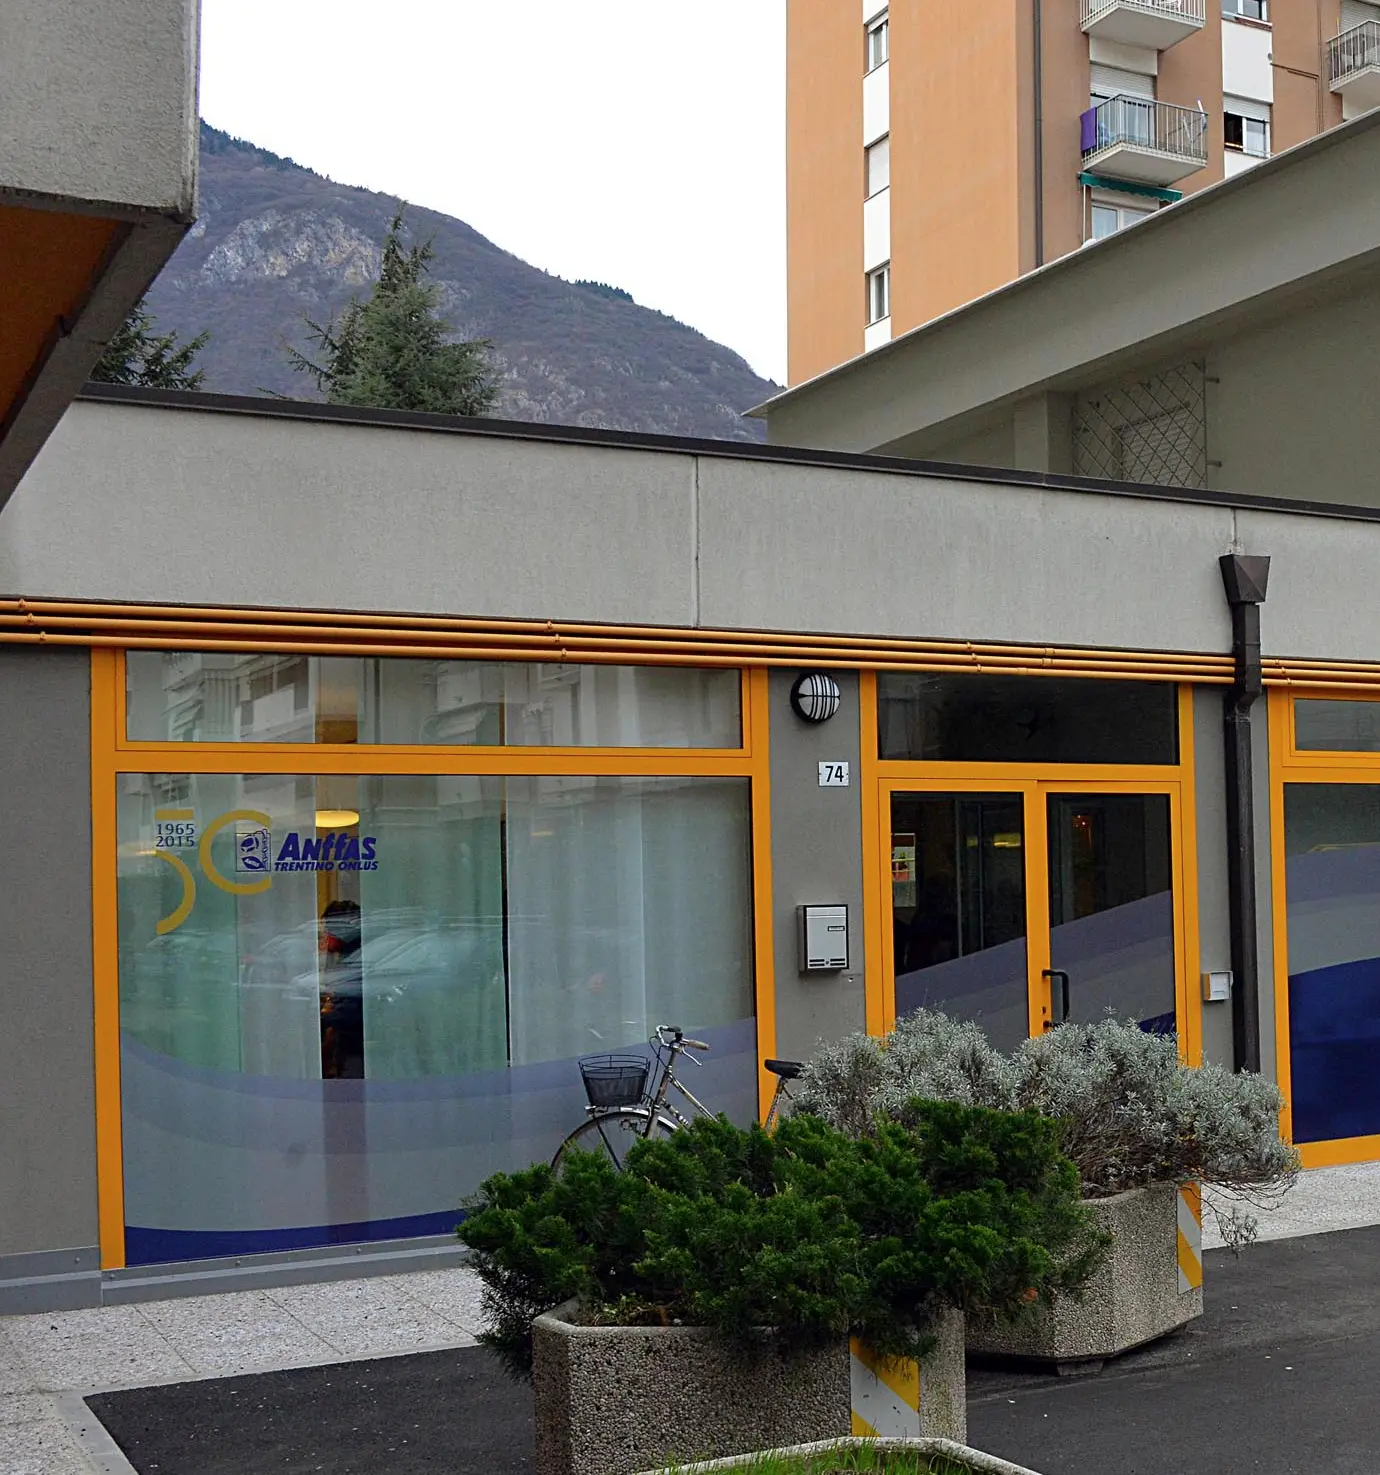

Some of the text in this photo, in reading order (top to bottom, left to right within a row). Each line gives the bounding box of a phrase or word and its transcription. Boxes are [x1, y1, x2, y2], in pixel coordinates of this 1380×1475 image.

[824, 765, 845, 783] 74
[156, 823, 195, 835] 1965
[155, 836, 196, 848] 2015
[274, 860, 379, 872] TRENTINO ONLUS
